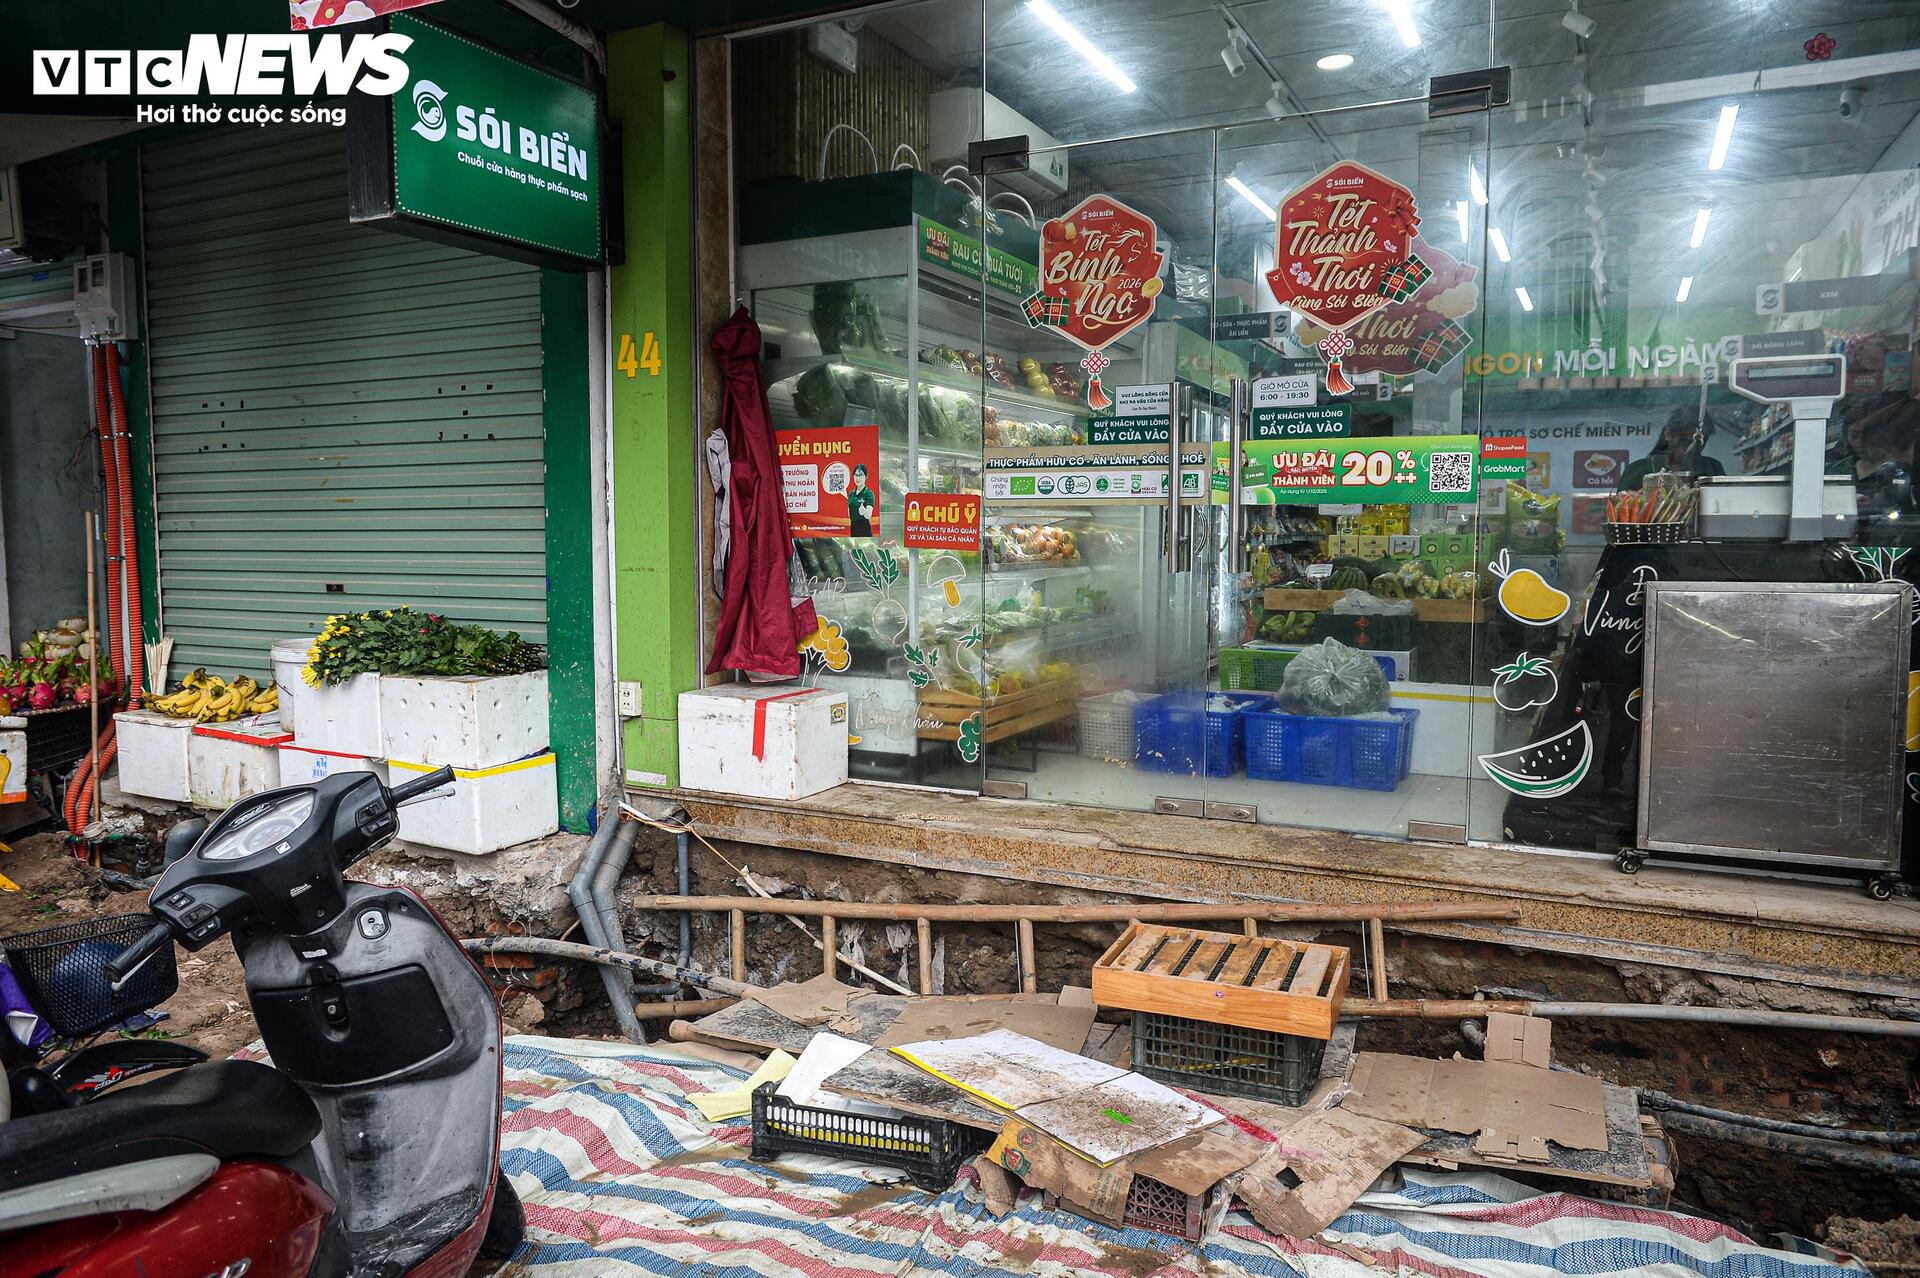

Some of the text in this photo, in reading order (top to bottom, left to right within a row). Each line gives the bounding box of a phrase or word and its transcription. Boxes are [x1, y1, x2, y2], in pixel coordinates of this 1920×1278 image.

[456, 105, 587, 181] SÓI BIỂN
[457, 151, 588, 202] Chuỗi cửa hàng thực phẩm sạch
[1327, 194, 1377, 230] Tết
[926, 227, 936, 241] ƯU
[937, 231, 950, 247] ĐÃI
[1082, 230, 1112, 252] Tết
[1288, 221, 1377, 256] Thảnh
[952, 241, 970, 261] RAU
[1005, 263, 1023, 283] TƯƠI
[1045, 248, 1129, 284] Bính
[1313, 256, 1376, 292] Thơi
[1117, 278, 1142, 290] 2026
[1075, 278, 1139, 330] Ngọ
[1290, 292, 1384, 311] Cùng Sói Biển
[1356, 307, 1418, 340] Thơi
[617, 332, 661, 378] 44
[1359, 343, 1377, 356] Sói
[1552, 338, 1616, 372] MỖI
[1628, 337, 1721, 369] NGÀY
[1260, 379, 1309, 391] GIỜ MỞ CỬA
[1260, 391, 1309, 401] 6:00 19:30
[1094, 419, 1109, 428] QUÝ
[1110, 418, 1135, 427] KHÁCH
[1149, 417, 1170, 426] LÒNG
[1260, 412, 1276, 421] QUÝ
[1277, 411, 1305, 420] KHÁCH
[1321, 409, 1344, 418] LÒNG
[1094, 428, 1169, 442] ĐẨY CỬA VÀO
[1260, 420, 1343, 435] ĐẨY CỬA VÀO
[1529, 427, 1551, 439] SƠ
[1553, 422, 1586, 438] CHẾ
[1587, 422, 1621, 437] MIỄN
[1626, 421, 1651, 437] PHÍ
[778, 435, 851, 458] UYỂN DỤNG
[990, 456, 1014, 470] THỰC
[1016, 453, 1044, 467] PHẨM
[1046, 454, 1066, 466] HỮU
[1068, 454, 1085, 466] CƠ
[1092, 454, 1107, 465] ĂN
[1110, 453, 1139, 465] LÀNH,
[1180, 450, 1204, 464] HOẺ
[1273, 449, 1336, 469] ƯU ĐÃI
[1341, 450, 1416, 486] 20 %
[1483, 464, 1525, 473] GrabMart
[797, 479, 815, 487] NGÂN
[1273, 474, 1309, 486] THÀNH
[1311, 473, 1336, 485] VIÊN
[1588, 476, 1614, 485] Cá hồi
[785, 490, 798, 498] BÁN
[795, 499, 807, 508] CHẾ
[923, 502, 976, 524] CHÚ Ý
[919, 525, 939, 533] KHÁCH
[947, 526, 960, 534] BẢO
[960, 526, 977, 535] QUẢN
[935, 534, 947, 542] SẢN
